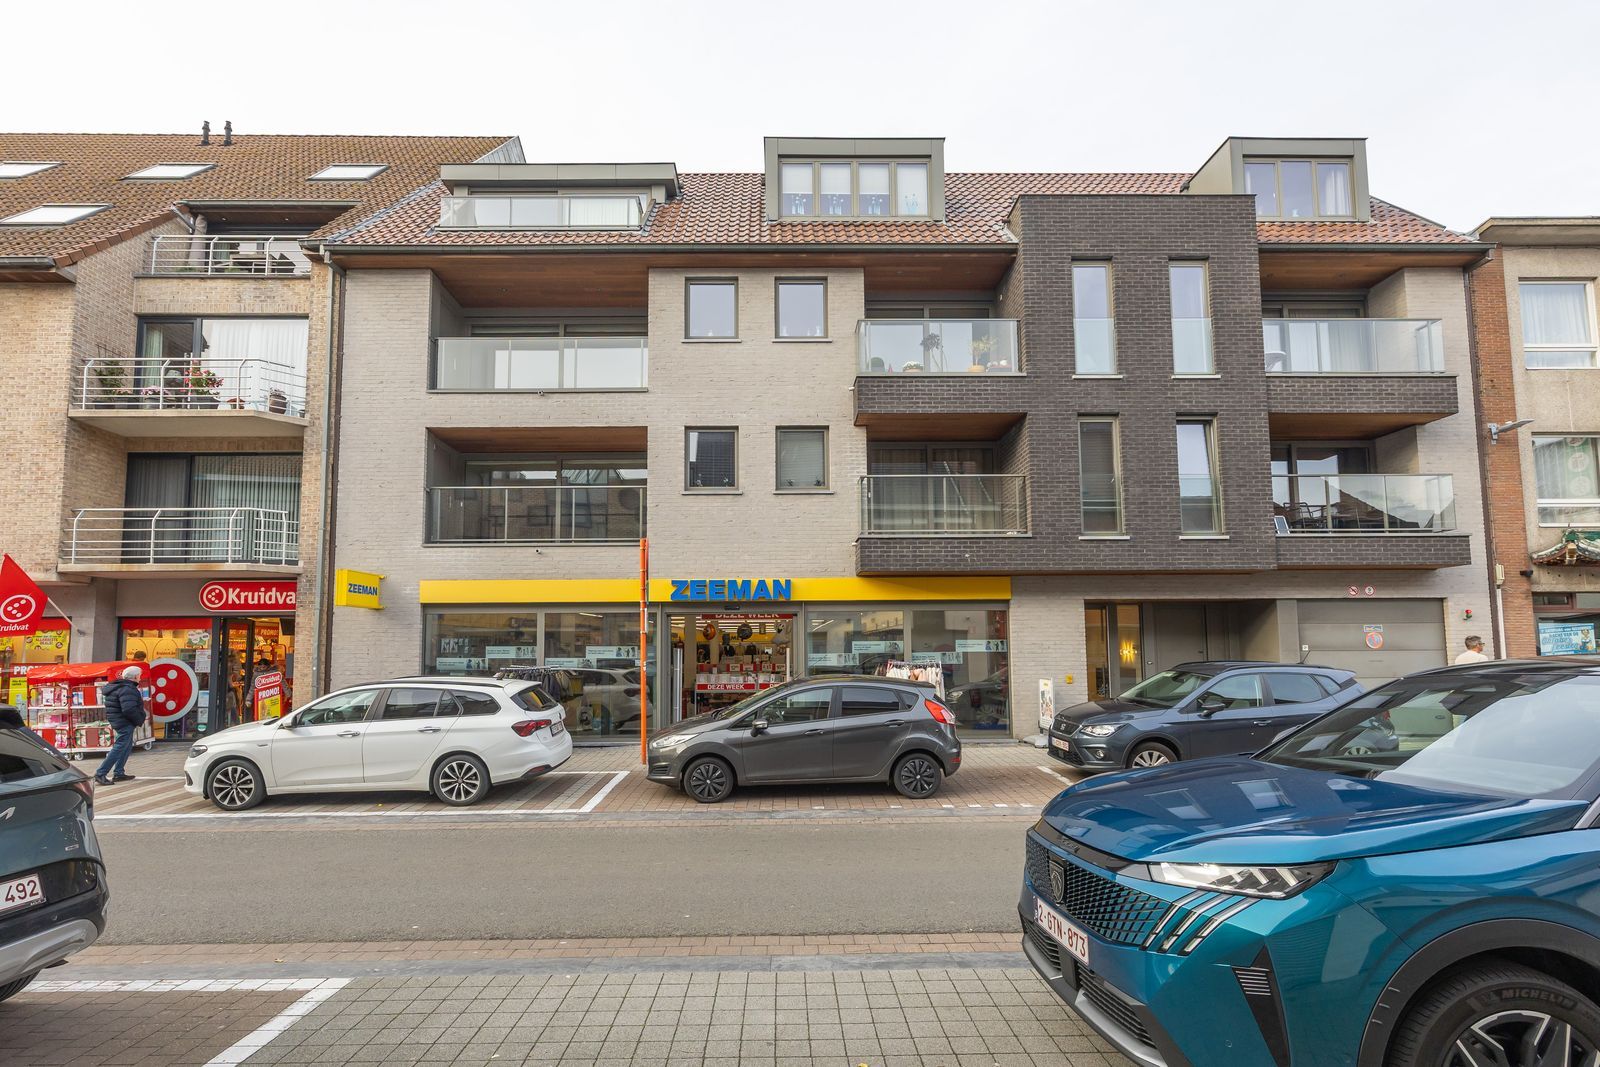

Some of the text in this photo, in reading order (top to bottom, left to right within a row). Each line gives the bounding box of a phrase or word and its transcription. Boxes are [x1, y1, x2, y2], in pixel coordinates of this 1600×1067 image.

[228, 587, 297, 605] Kruidva
[347, 583, 378, 596] ZEEMAN
[670, 579, 792, 601] ZEEMAN
[0, 623, 30, 632] ruidvat
[258, 686, 280, 699] PROMO!
[5, 879, 39, 903] 492
[1039, 904, 1086, 958] 2-GTN-873
[1502, 988, 1575, 1009] MICHELIN
